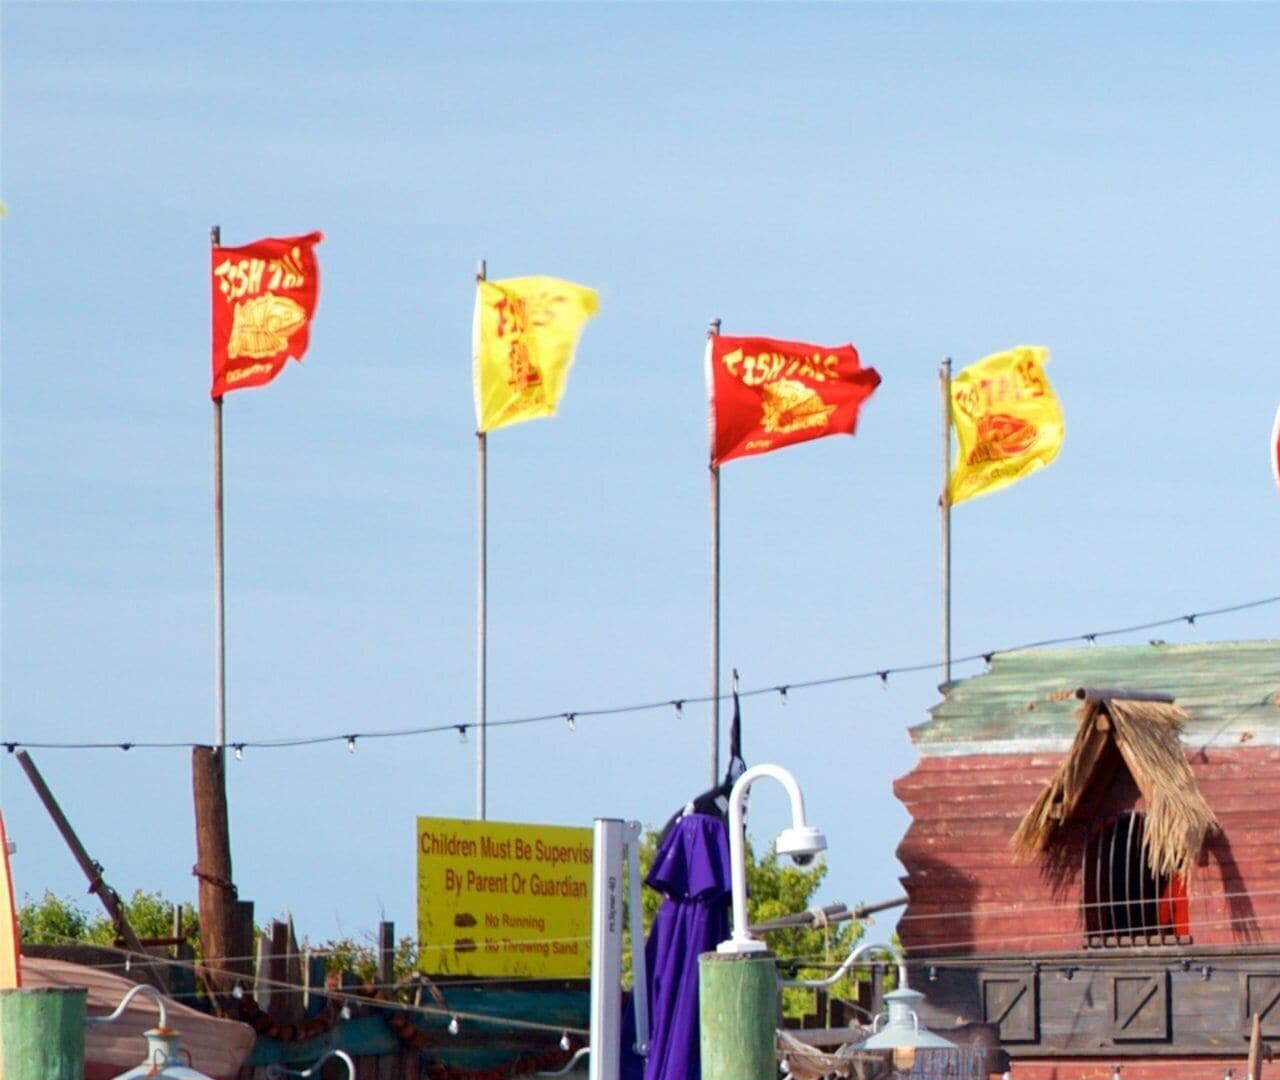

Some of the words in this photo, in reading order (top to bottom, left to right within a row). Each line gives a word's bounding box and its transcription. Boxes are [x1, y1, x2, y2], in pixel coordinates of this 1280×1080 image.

[421, 832, 477, 858] Children
[480, 837, 512, 860] Must
[515, 839, 531, 860] Be
[535, 840, 594, 868] Supervis
[445, 868, 462, 897] By
[467, 870, 508, 894] Parent
[512, 873, 527, 894] Or
[530, 874, 588, 899] Guardian
[485, 913, 499, 926] No
[502, 914, 545, 932] Running
[485, 938, 499, 952] No
[503, 940, 549, 957] Throwing
[552, 942, 578, 955] Sand
